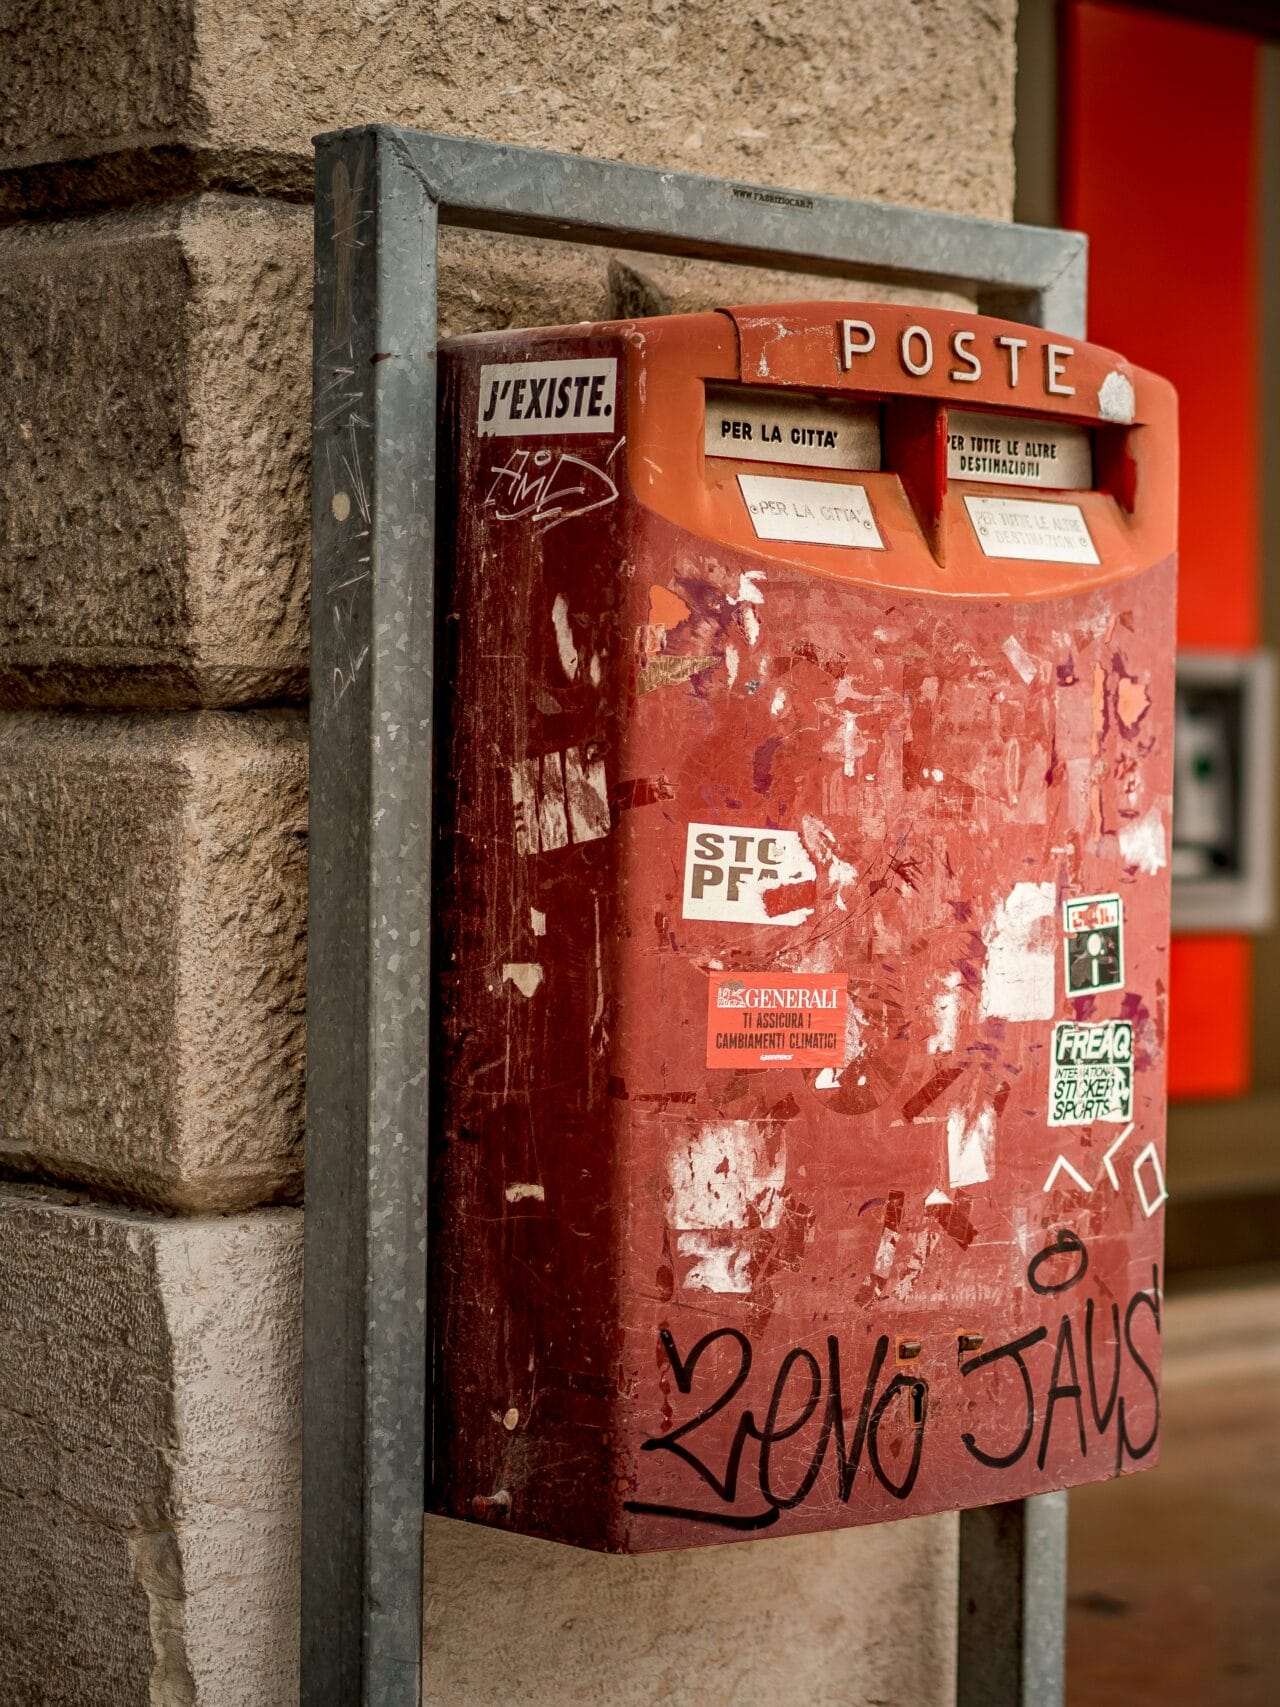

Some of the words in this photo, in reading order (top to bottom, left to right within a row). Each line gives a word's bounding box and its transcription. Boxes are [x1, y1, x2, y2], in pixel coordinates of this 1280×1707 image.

[839, 319, 1076, 395] POSTE
[483, 375, 612, 422] J'EXISTE.
[721, 420, 752, 441] PER
[761, 424, 782, 443] LA
[790, 428, 838, 448] CITTA'
[971, 437, 1001, 454] TUTTE
[1008, 441, 1020, 457] LE
[1025, 443, 1057, 460] ALTRE
[960, 456, 1040, 478] DESTINAZIONI
[759, 501, 789, 517] PER
[792, 503, 815, 519] LA
[1034, 515, 1050, 530] LE
[745, 988, 839, 1009] GENERALI
[743, 1012, 752, 1029] TI
[756, 1012, 804, 1029] ASSICURA
[808, 1012, 812, 1028] I
[716, 1032, 786, 1050] CAMBIAMENTI
[789, 1032, 837, 1050] CLIMATICI
[1057, 1025, 1132, 1061] FREAQ
